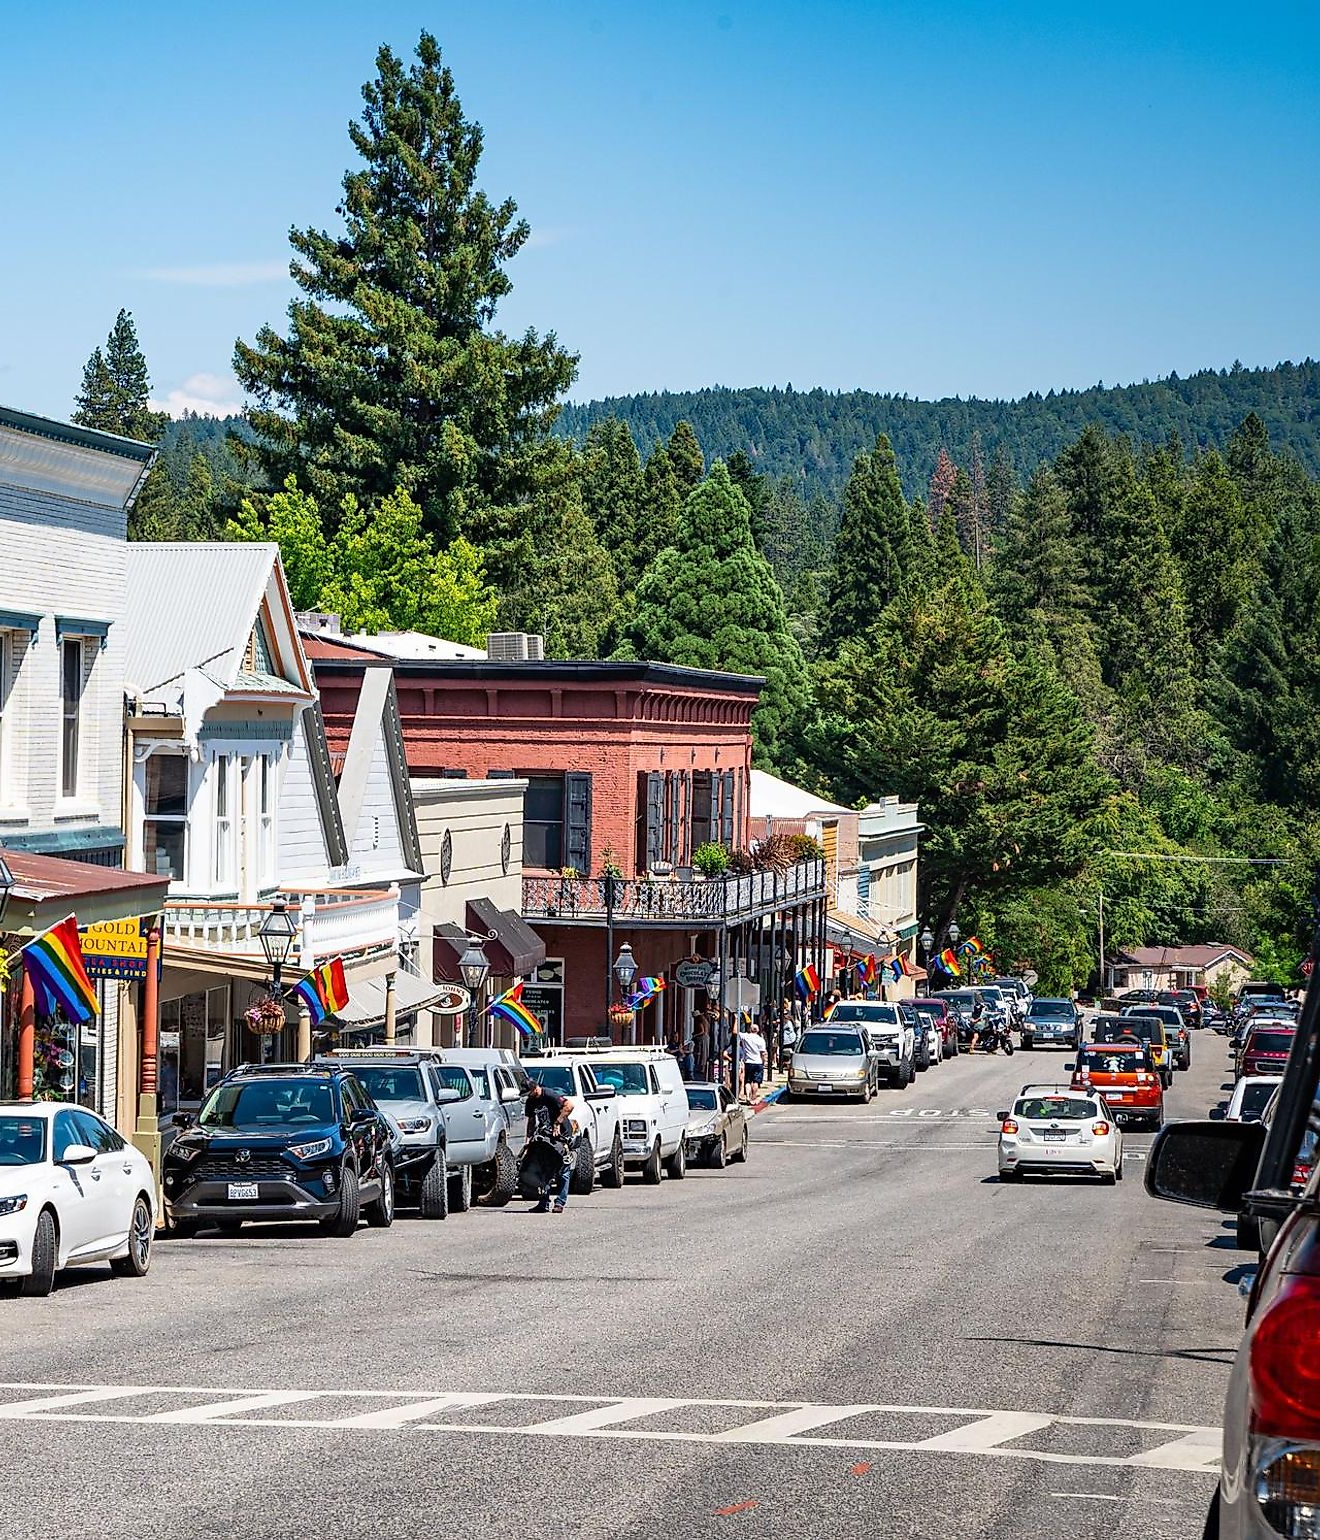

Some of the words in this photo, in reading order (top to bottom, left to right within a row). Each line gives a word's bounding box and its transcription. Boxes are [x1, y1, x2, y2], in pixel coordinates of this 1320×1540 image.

[92, 922, 136, 934] GOLD
[80, 938, 148, 953] OUNTAI
[111, 959, 144, 968] SHOP
[123, 969, 147, 977] FIND
[889, 1107, 990, 1117] STOP
